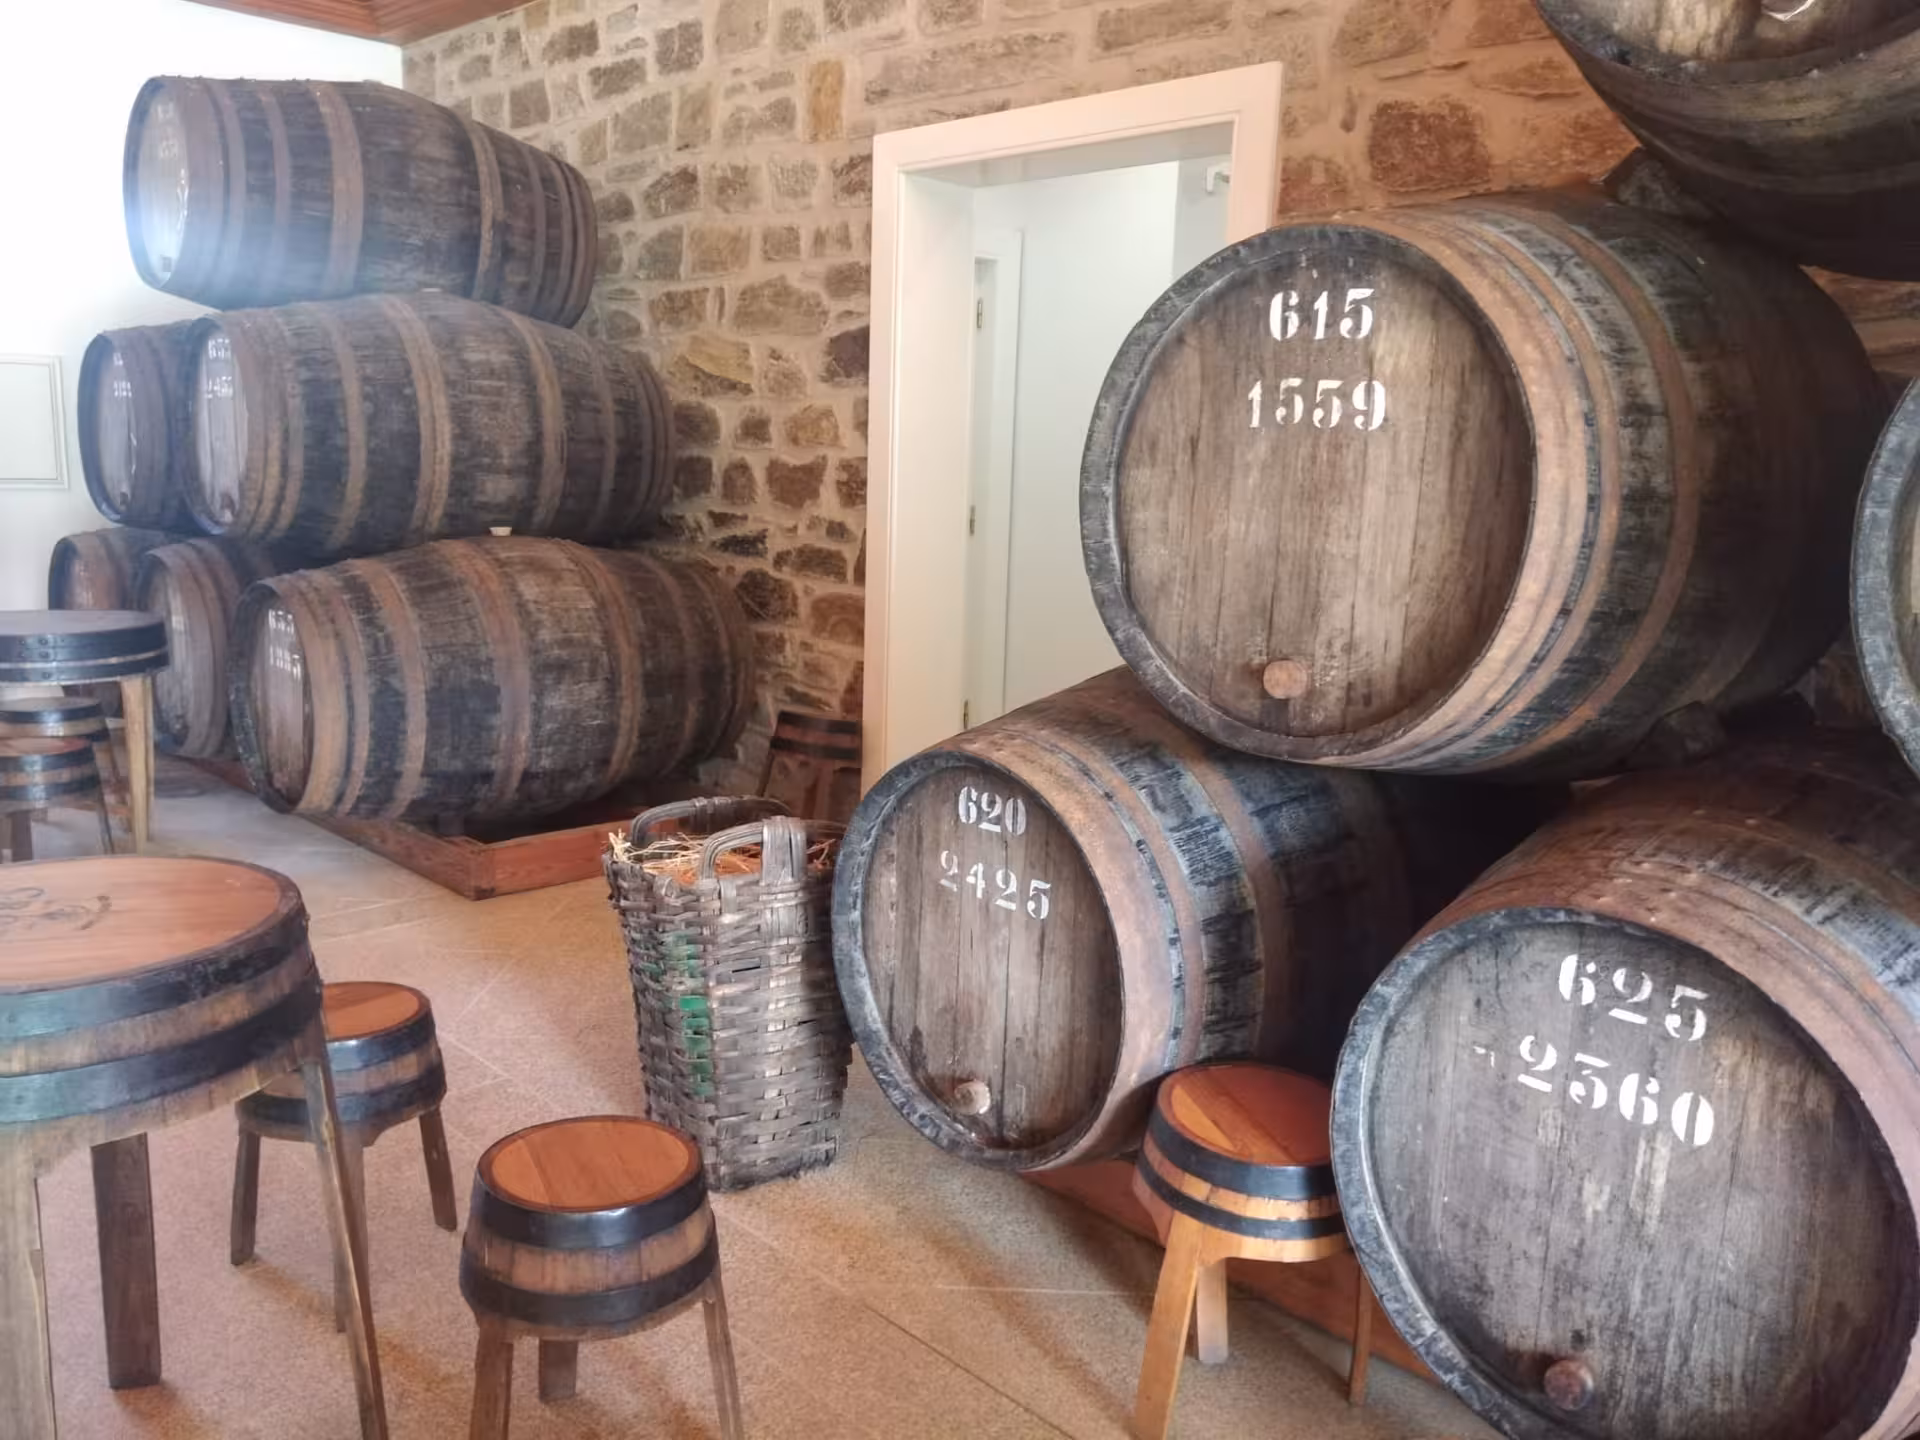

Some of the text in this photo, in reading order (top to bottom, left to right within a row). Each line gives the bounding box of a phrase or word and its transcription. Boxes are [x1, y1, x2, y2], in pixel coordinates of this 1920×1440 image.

[1269, 288, 1375, 341] 615
[1248, 378, 1386, 431] 1559
[958, 786, 1027, 836] 620
[938, 850, 1052, 920] 2425
[1558, 953, 1710, 1042] 625
[1517, 1035, 1715, 1147] 2560
